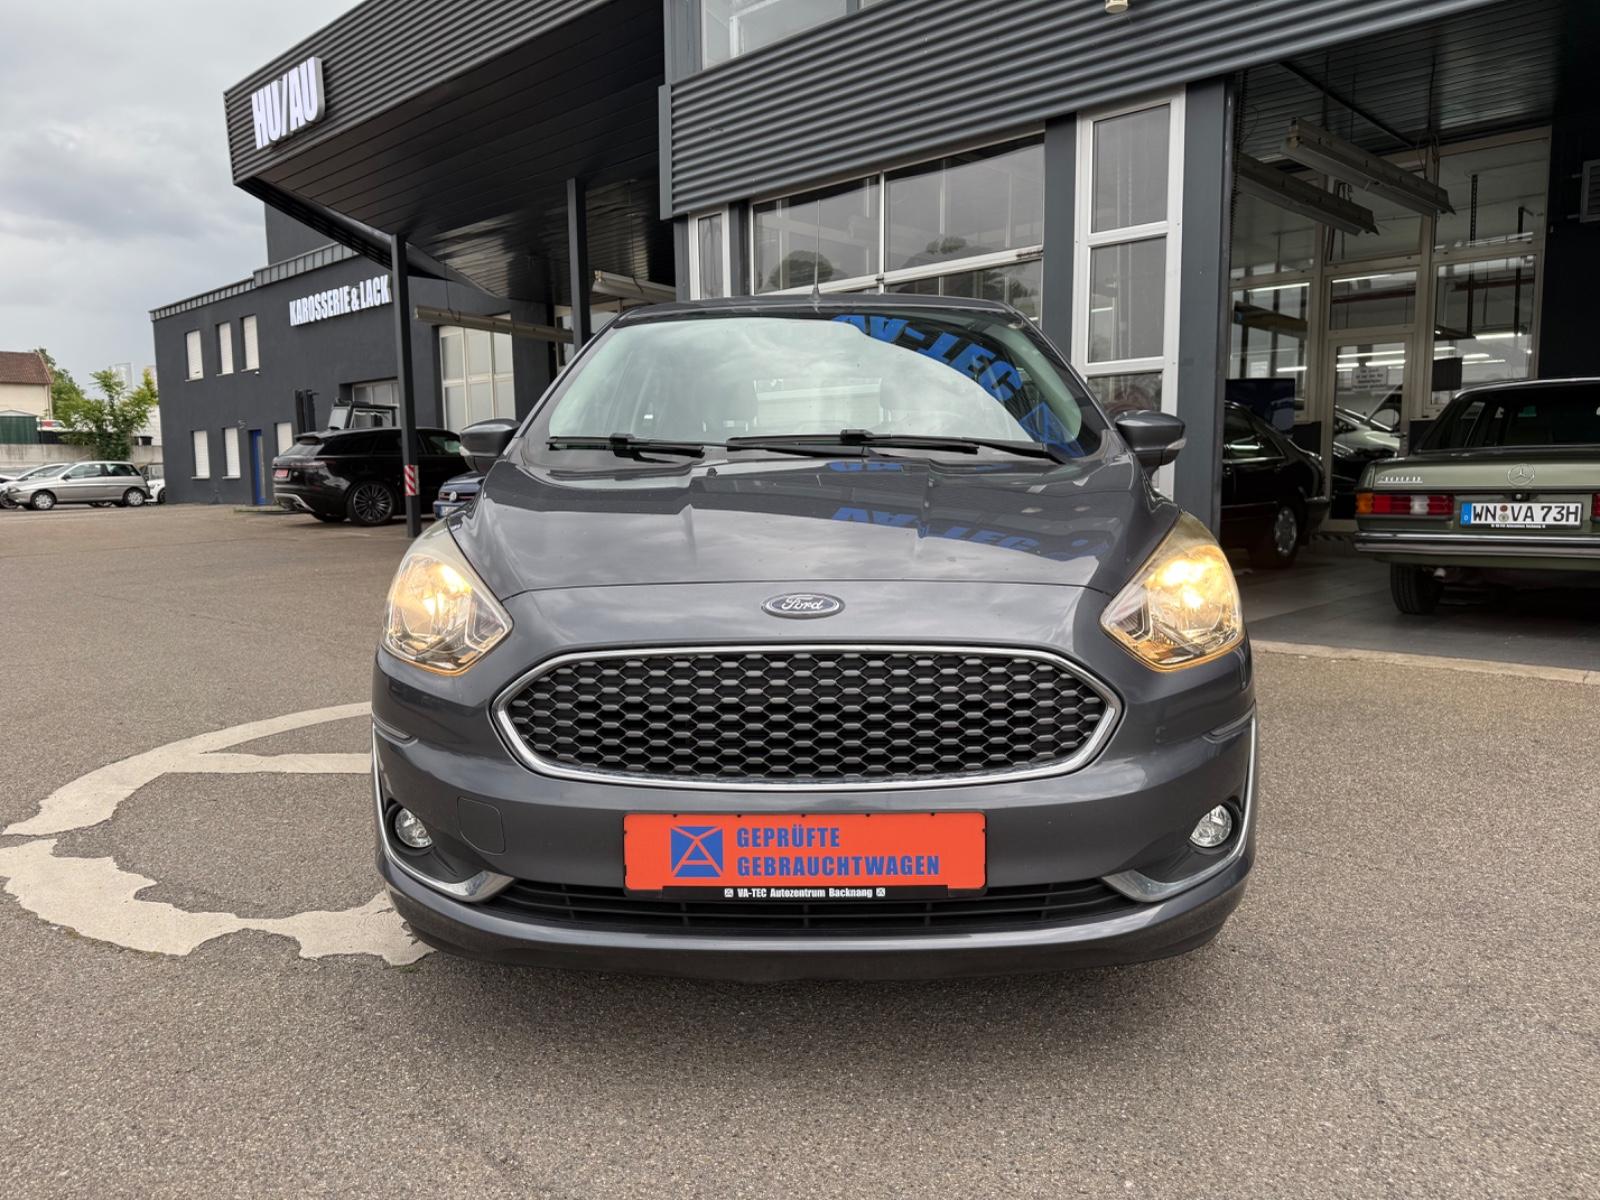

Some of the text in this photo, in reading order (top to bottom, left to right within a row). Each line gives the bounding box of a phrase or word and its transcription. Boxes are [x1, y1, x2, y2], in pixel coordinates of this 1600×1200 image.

[251, 56, 325, 150] HU/AU
[289, 274, 391, 327] KAROSSERIE & LACK
[1473, 505, 1579, 522] WN VA 73H
[781, 595, 824, 610] Ford
[736, 824, 840, 848] GEPRÜFTE
[737, 855, 940, 876] GEBRAUCHTWAGEN
[737, 888, 873, 898] VA-TEC Autozentrum Backnang
